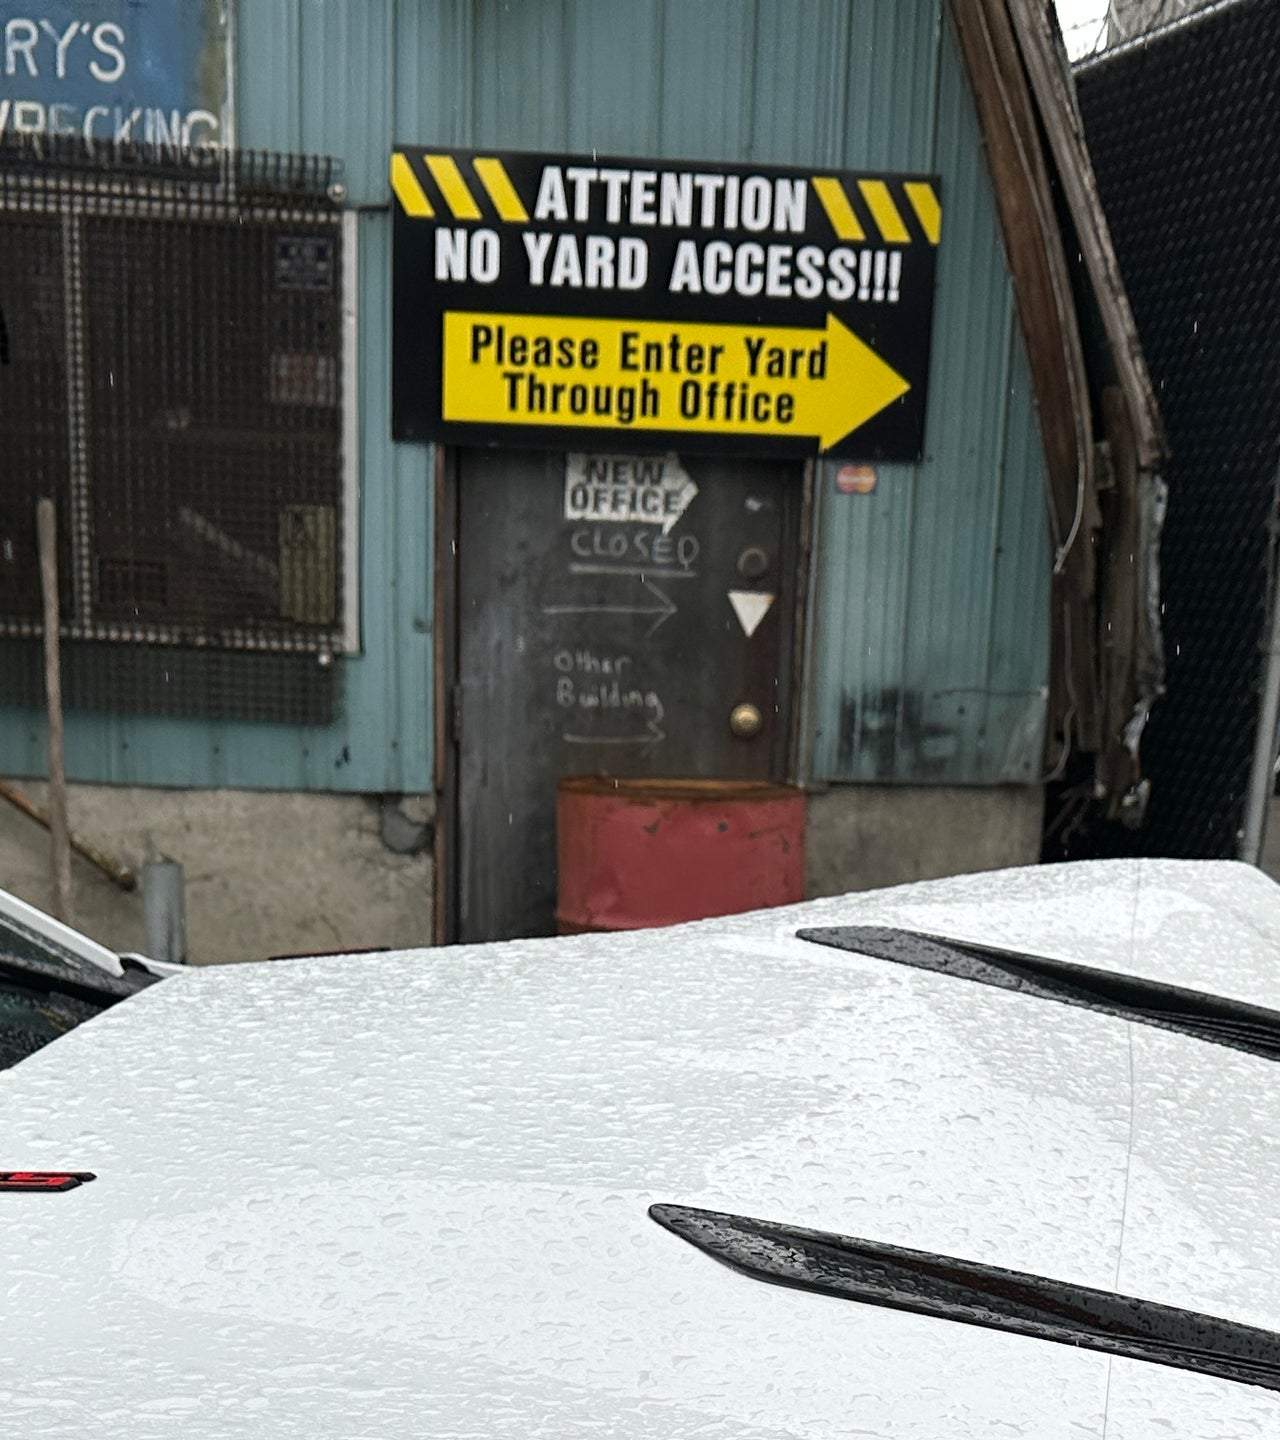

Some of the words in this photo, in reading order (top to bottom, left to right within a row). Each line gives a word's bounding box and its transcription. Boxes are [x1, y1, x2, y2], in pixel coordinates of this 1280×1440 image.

[535, 166, 808, 233] ATTENTION
[434, 228, 501, 284] NO
[523, 233, 648, 291] YARD
[669, 240, 903, 302] ACCESS!!!
[470, 325, 599, 369] Please
[619, 332, 725, 375] Enter
[744, 337, 828, 381] Yard
[503, 372, 660, 425] Through
[679, 380, 796, 424] Office
[586, 460, 666, 486] NEW
[570, 486, 682, 516] OFFICE
[552, 650, 634, 676] Other
[555, 676, 664, 728] Building
